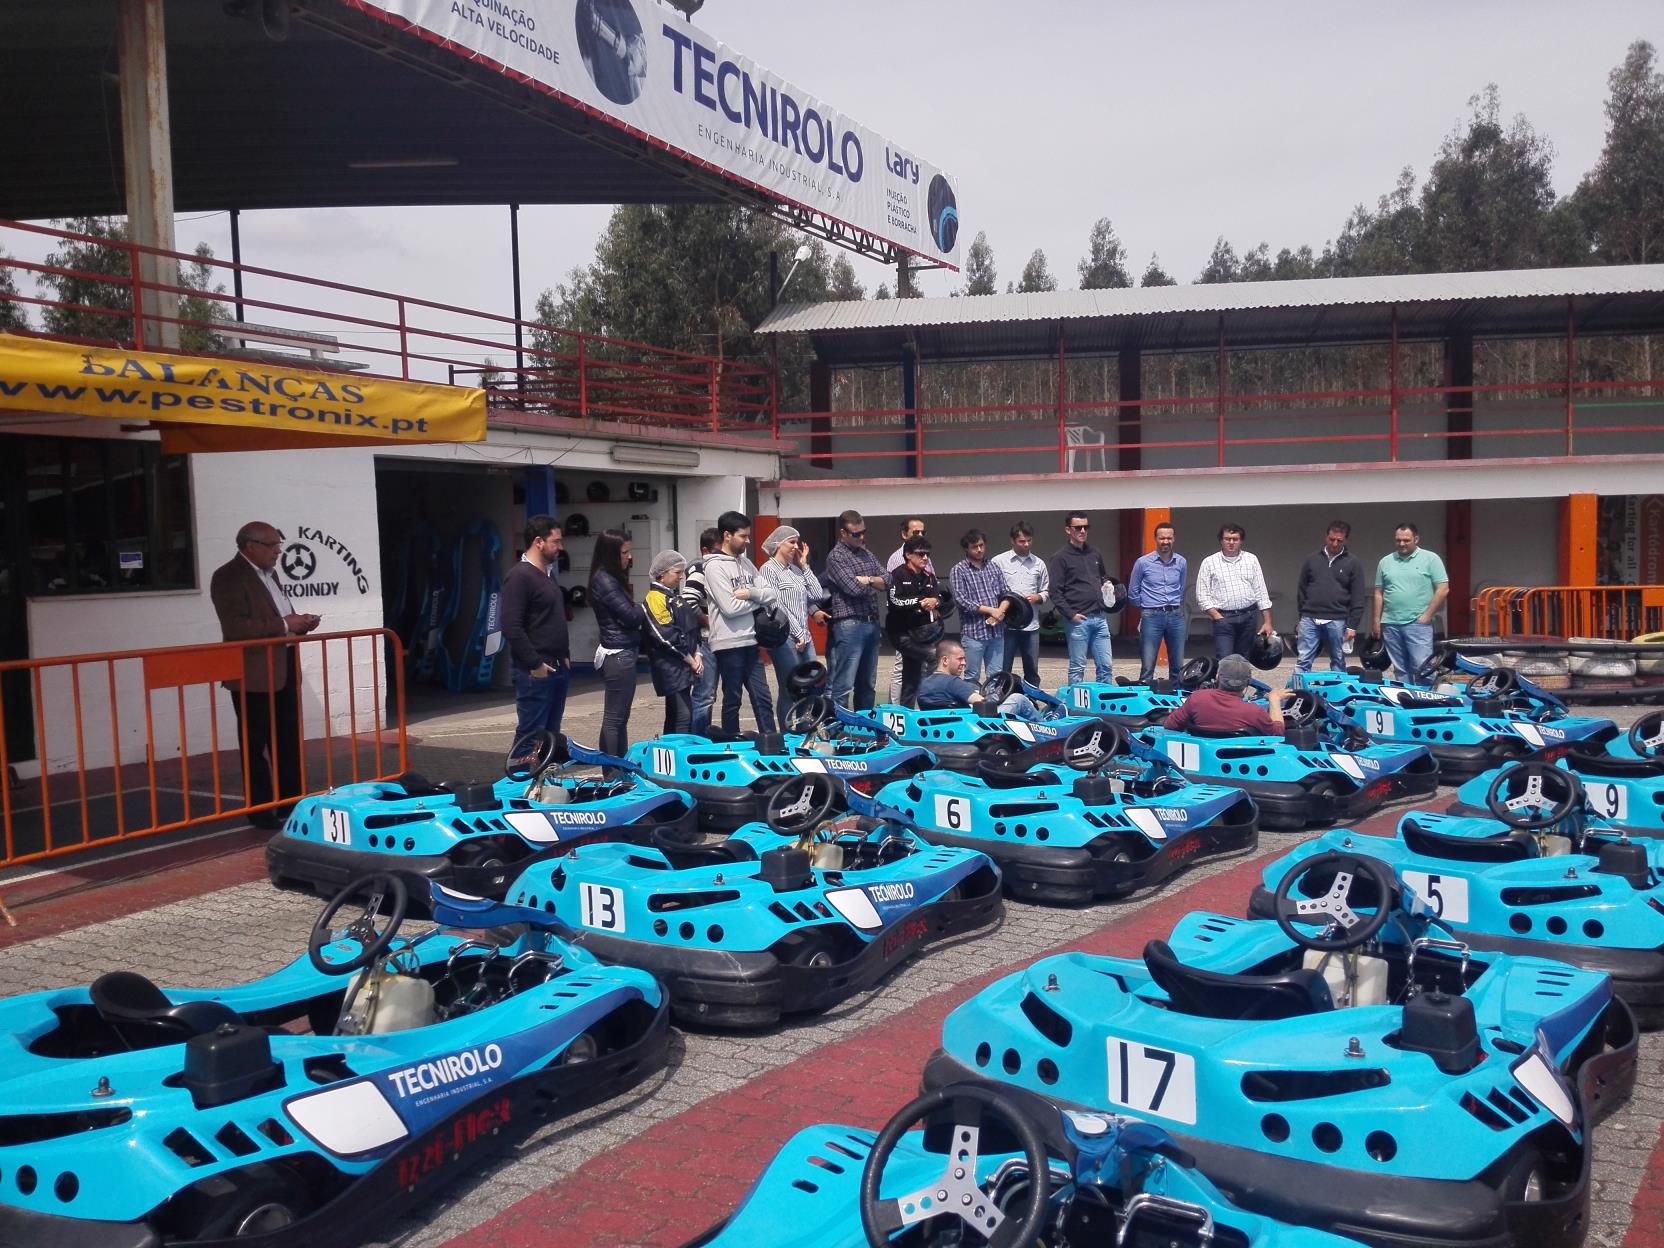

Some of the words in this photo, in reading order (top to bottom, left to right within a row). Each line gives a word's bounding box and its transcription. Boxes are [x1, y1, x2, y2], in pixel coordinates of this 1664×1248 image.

[451, 2, 485, 27] ALTA
[487, 17, 560, 65] VELOCIDADE
[662, 23, 864, 183] TECNIROLO
[698, 124, 765, 167] ENGENHARIA
[298, 526, 369, 595] KARTING
[281, 582, 339, 598] ROINDY
[487, 592, 498, 631] TECNIROLO
[1079, 688, 1089, 709] 16
[1376, 710, 1383, 734] 9
[658, 749, 672, 775] 10
[825, 759, 867, 772] TECNIROLO
[330, 809, 346, 843] 31
[550, 812, 606, 825] TECNIROLO
[947, 798, 961, 829] 6
[1154, 808, 1188, 821] TECNIROLO
[587, 885, 616, 929] 13
[868, 882, 914, 903] TECNIROLO
[1428, 874, 1444, 919] 5
[388, 1043, 502, 1098] TECNIROLO
[1119, 1041, 1176, 1112] 17
[415, 1091, 450, 1107] ENGENHARIA
